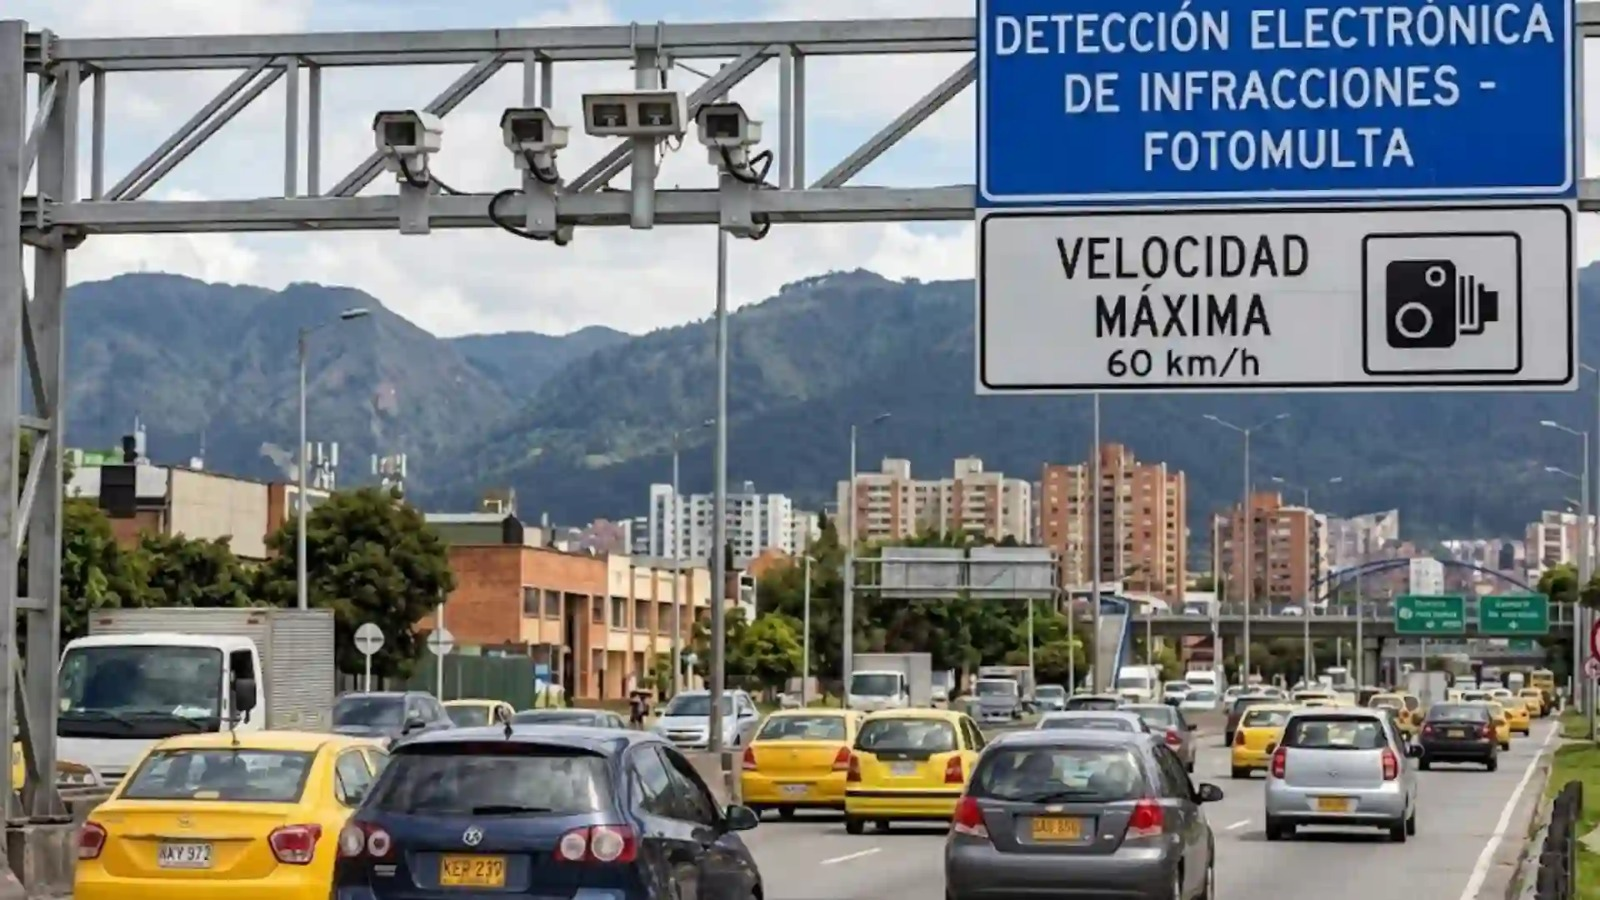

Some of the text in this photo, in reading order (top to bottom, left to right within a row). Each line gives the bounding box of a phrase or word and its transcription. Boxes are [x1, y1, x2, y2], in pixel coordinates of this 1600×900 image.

[996, 0, 1554, 55] DETECCIÓN ELECTRÓNICA
[1065, 73, 1120, 113] DE
[1141, 65, 1460, 112] INFRACCIONES
[1145, 127, 1414, 171] FOTOMULTA
[1056, 234, 1309, 280] VELOCIDAD
[1095, 283, 1271, 339] MÁXIMA
[1107, 347, 1260, 378] 60 km/h
